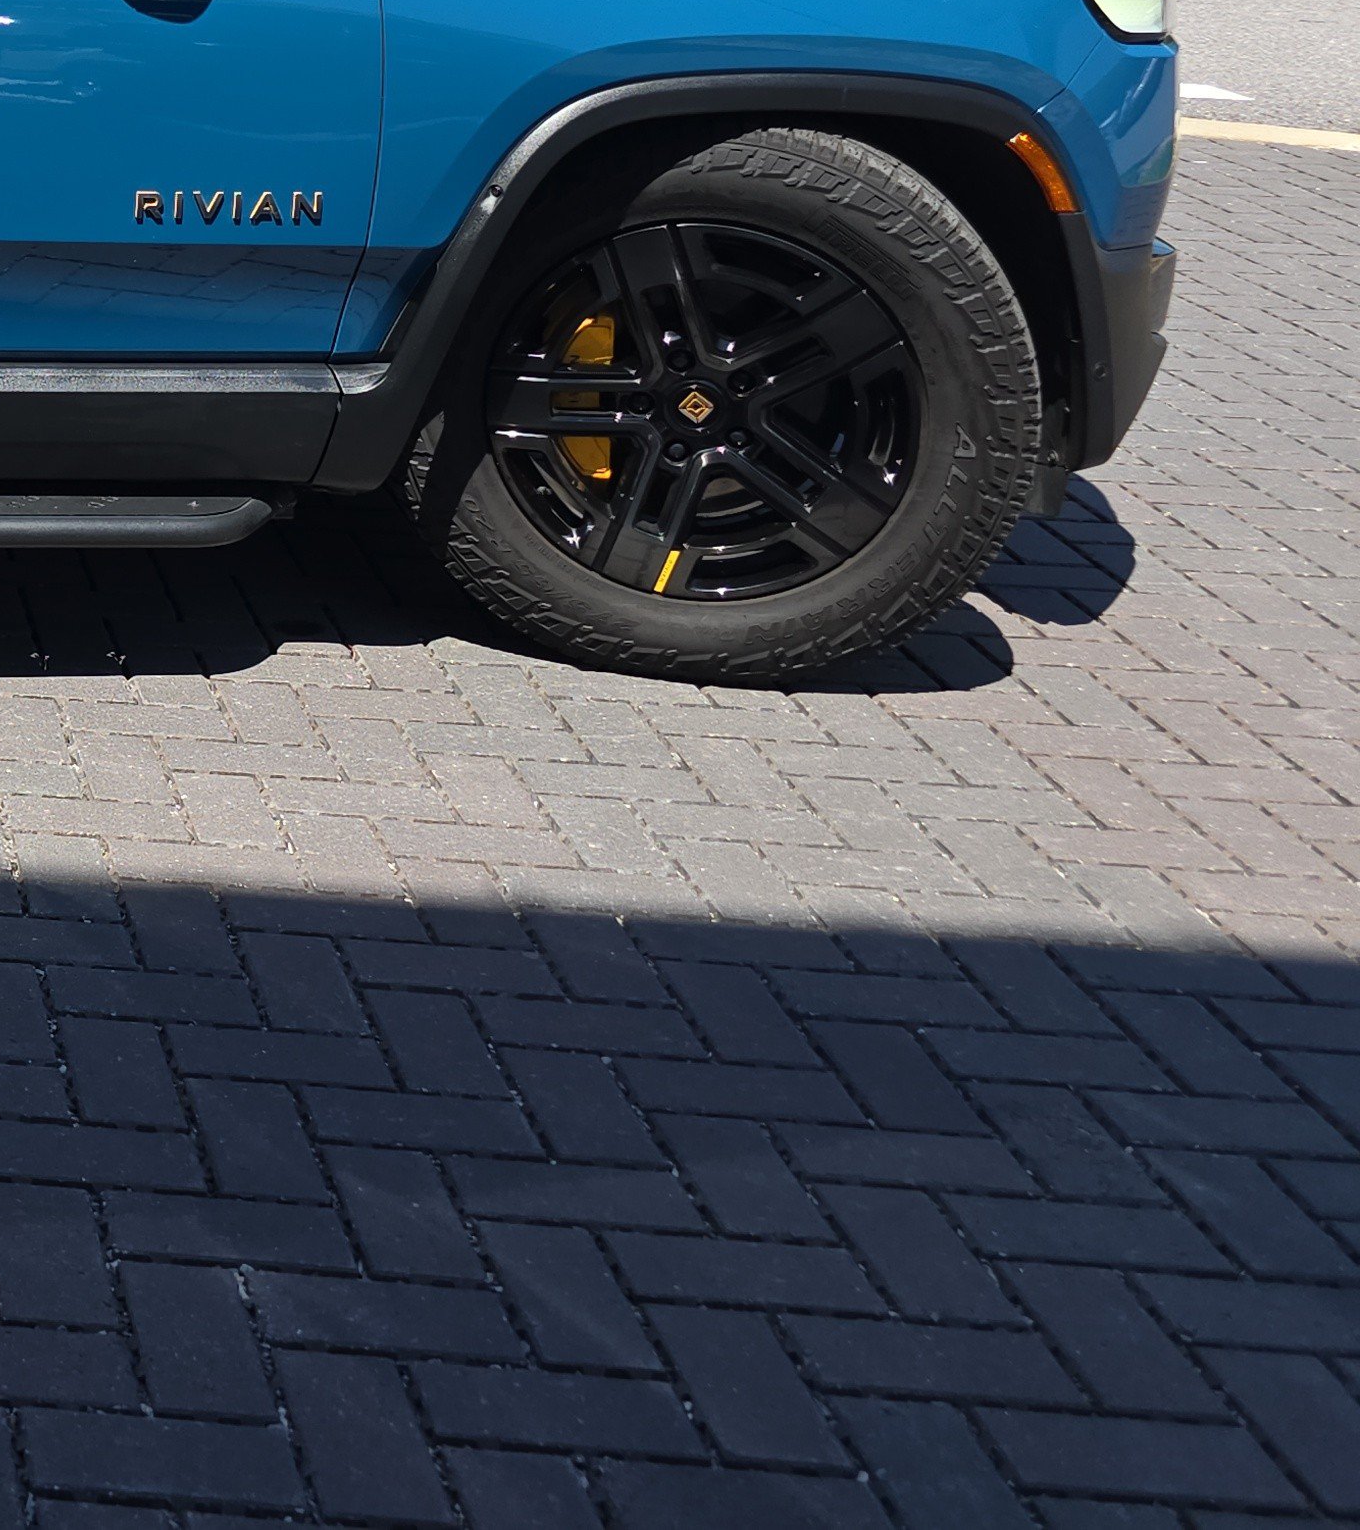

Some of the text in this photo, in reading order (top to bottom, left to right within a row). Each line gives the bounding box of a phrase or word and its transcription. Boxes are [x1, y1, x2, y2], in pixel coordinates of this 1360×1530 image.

[134, 190, 323, 225] RIVIAN
[741, 422, 978, 646] ALL TERRAIN
